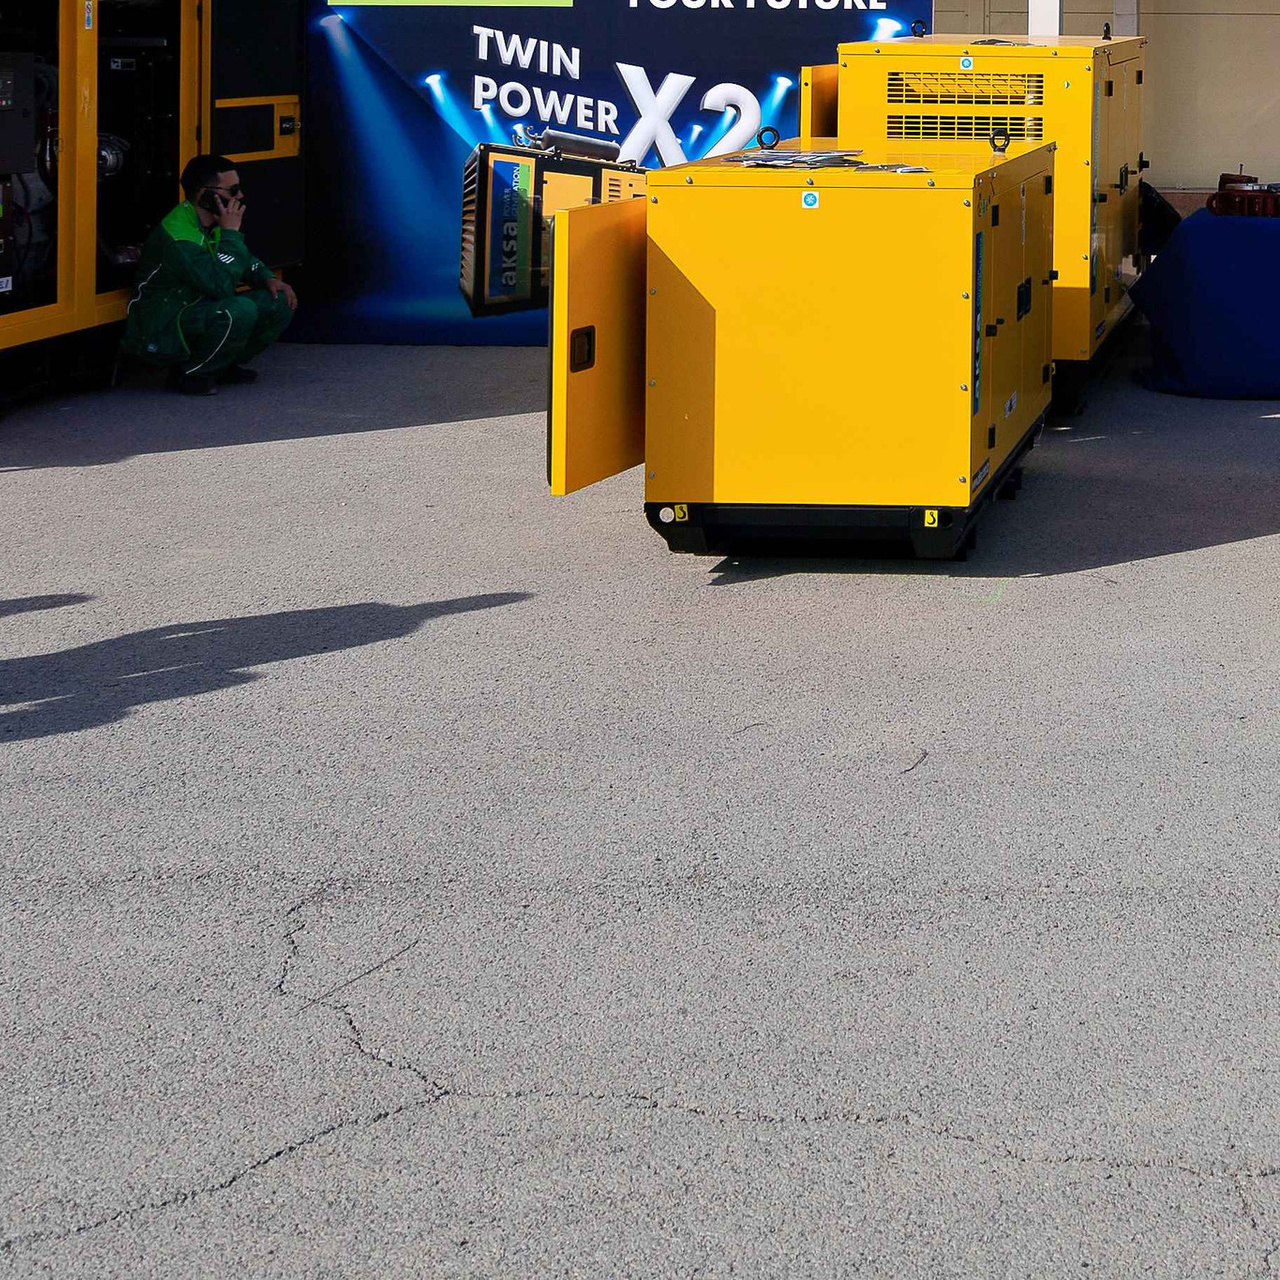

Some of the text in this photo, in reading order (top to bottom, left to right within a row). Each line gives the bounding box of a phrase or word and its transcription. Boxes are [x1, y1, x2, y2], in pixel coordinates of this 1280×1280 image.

[472, 24, 580, 80] TWIN
[473, 74, 621, 135] POWER
[615, 61, 762, 168] X2
[502, 221, 517, 286] aksa
